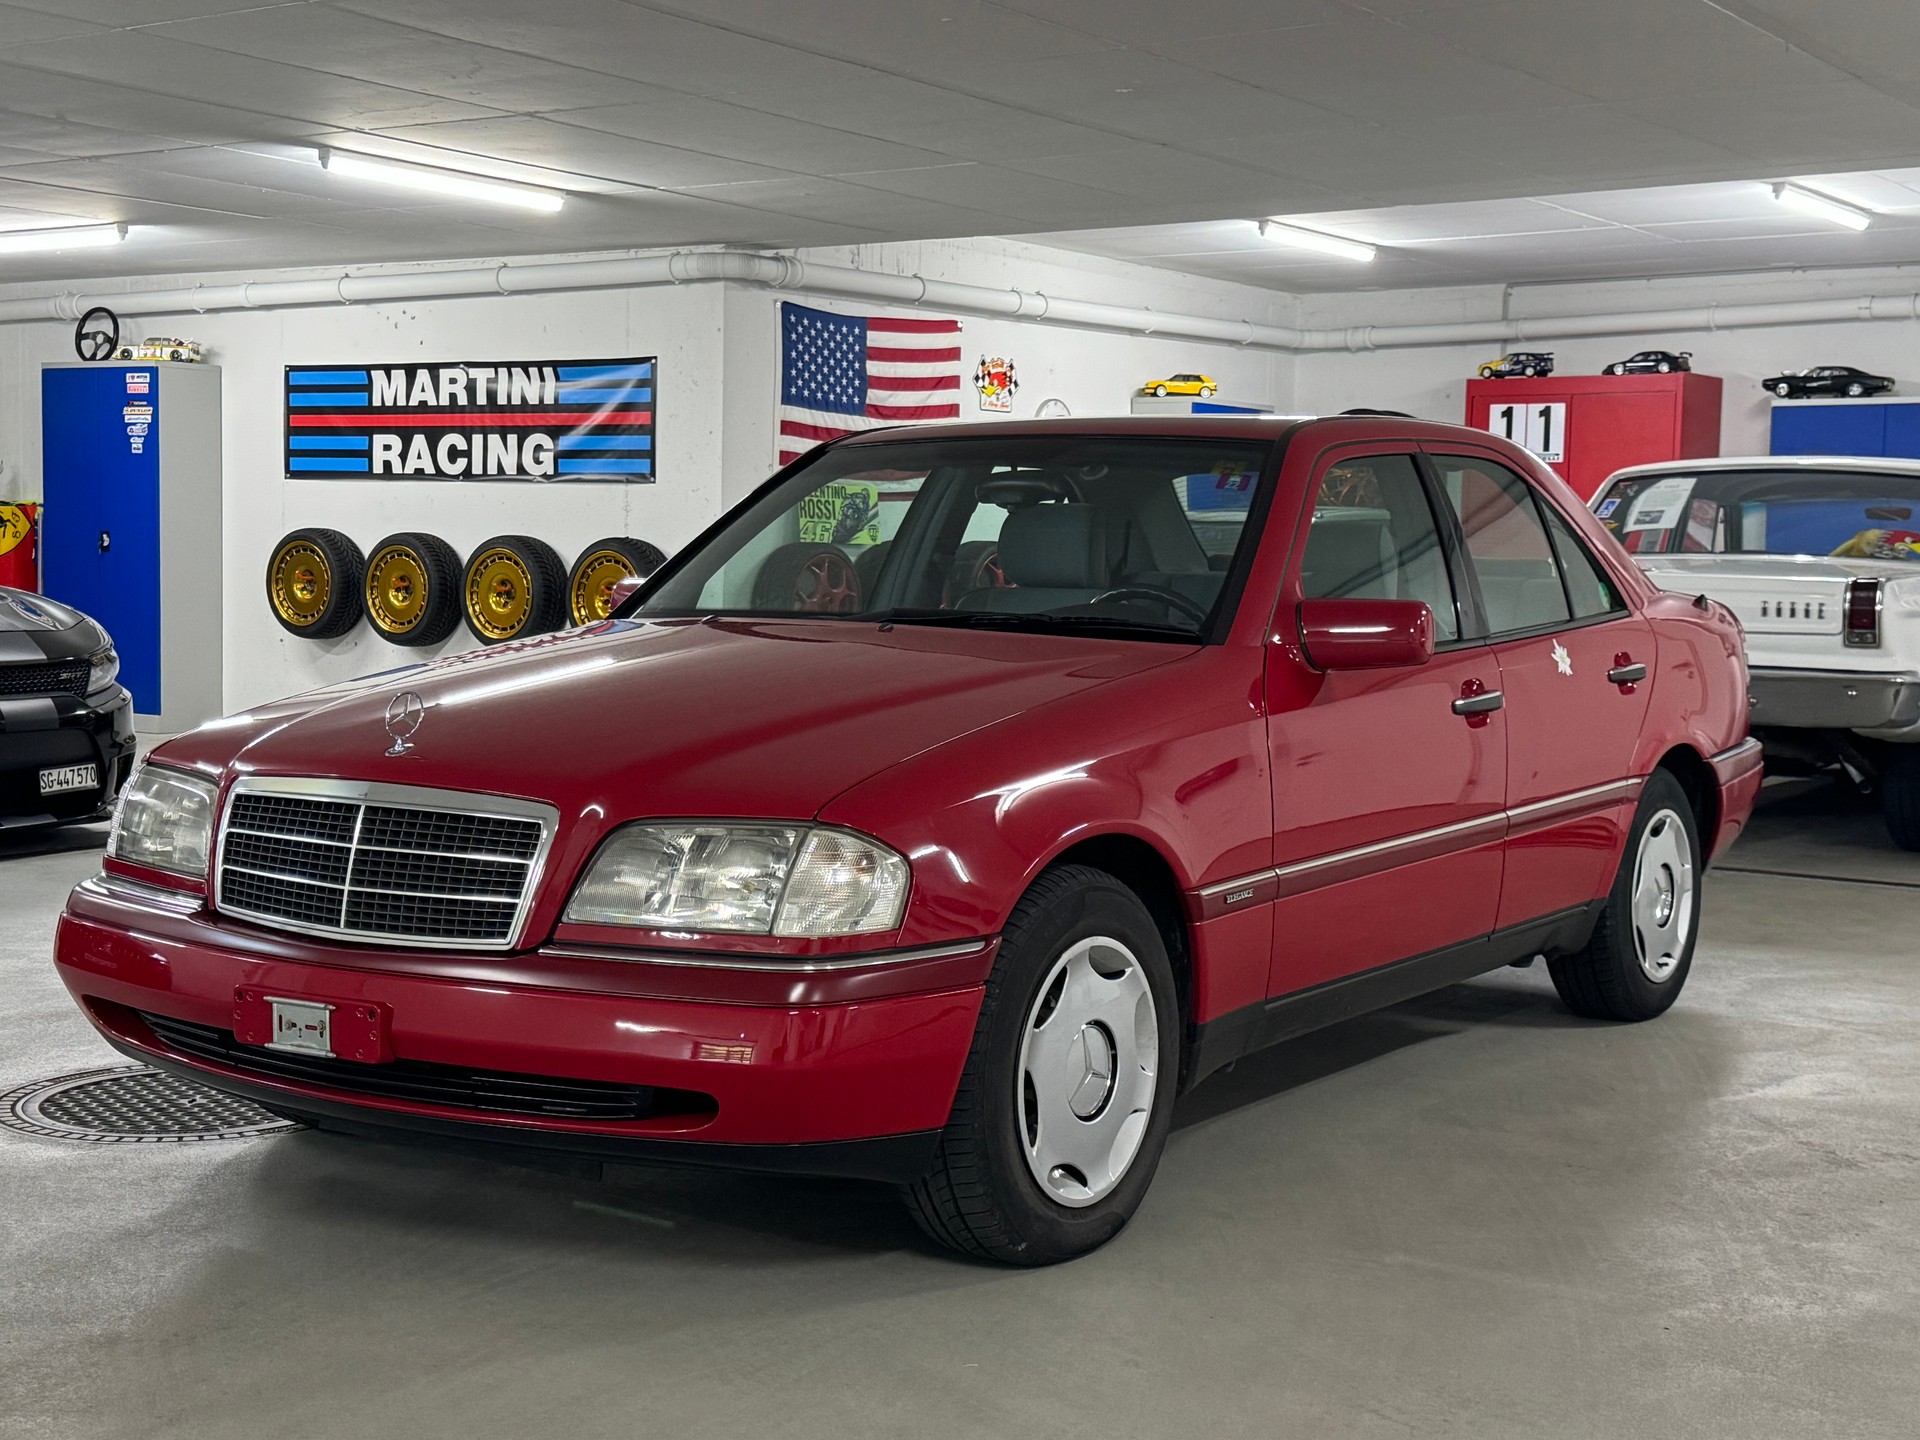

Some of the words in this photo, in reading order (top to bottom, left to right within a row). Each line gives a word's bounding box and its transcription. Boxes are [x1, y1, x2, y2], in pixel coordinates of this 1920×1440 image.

[371, 367, 556, 406] MARTINI
[372, 433, 555, 475] RACING
[810, 485, 847, 499] ENTINO
[800, 499, 836, 520] ROSSI
[800, 521, 832, 543] 46
